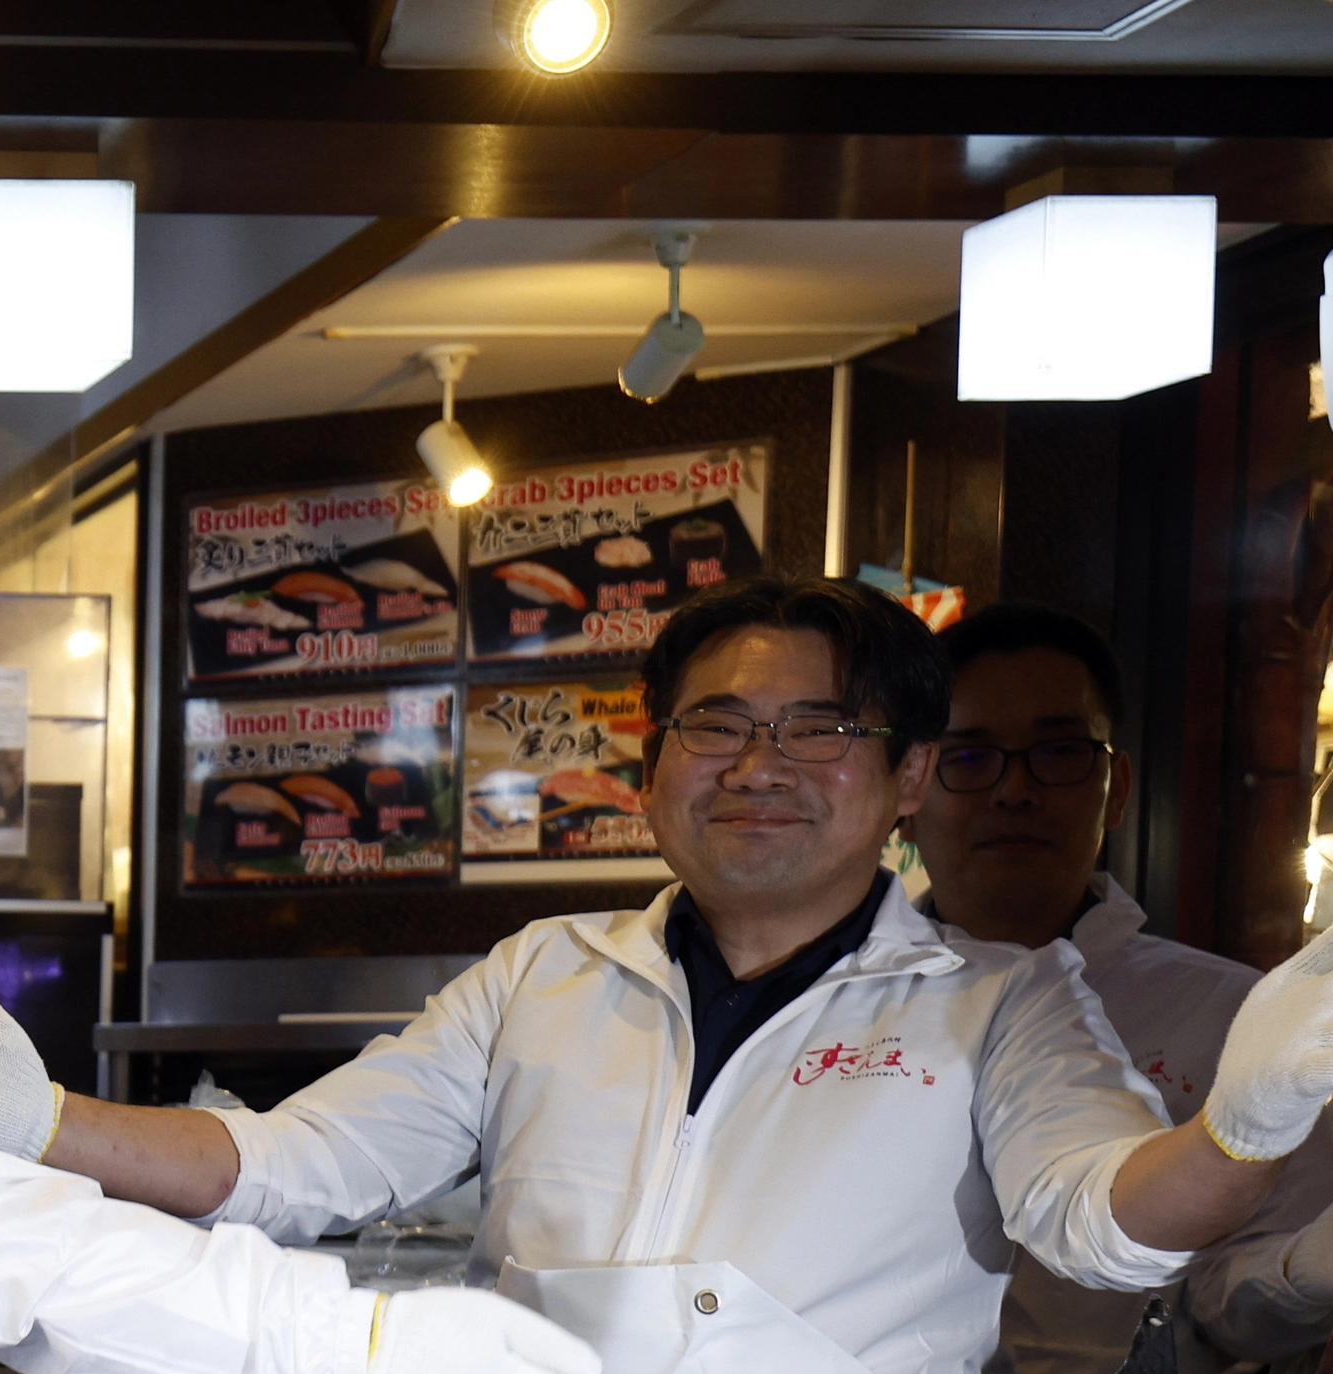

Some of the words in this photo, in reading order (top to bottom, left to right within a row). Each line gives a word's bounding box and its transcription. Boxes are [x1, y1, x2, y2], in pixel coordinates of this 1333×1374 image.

[556, 470, 678, 506] 3pieces
[688, 457, 743, 489] Set
[195, 504, 288, 534] Broiled
[295, 494, 398, 528] 3pieces
[405, 486, 450, 513] Se
[296, 630, 378, 662] 910円
[191, 712, 288, 738] Salmon
[294, 702, 393, 733] Tasting
[481, 687, 572, 733] くじら
[581, 696, 637, 717] Whale
[299, 838, 383, 873] 773円
